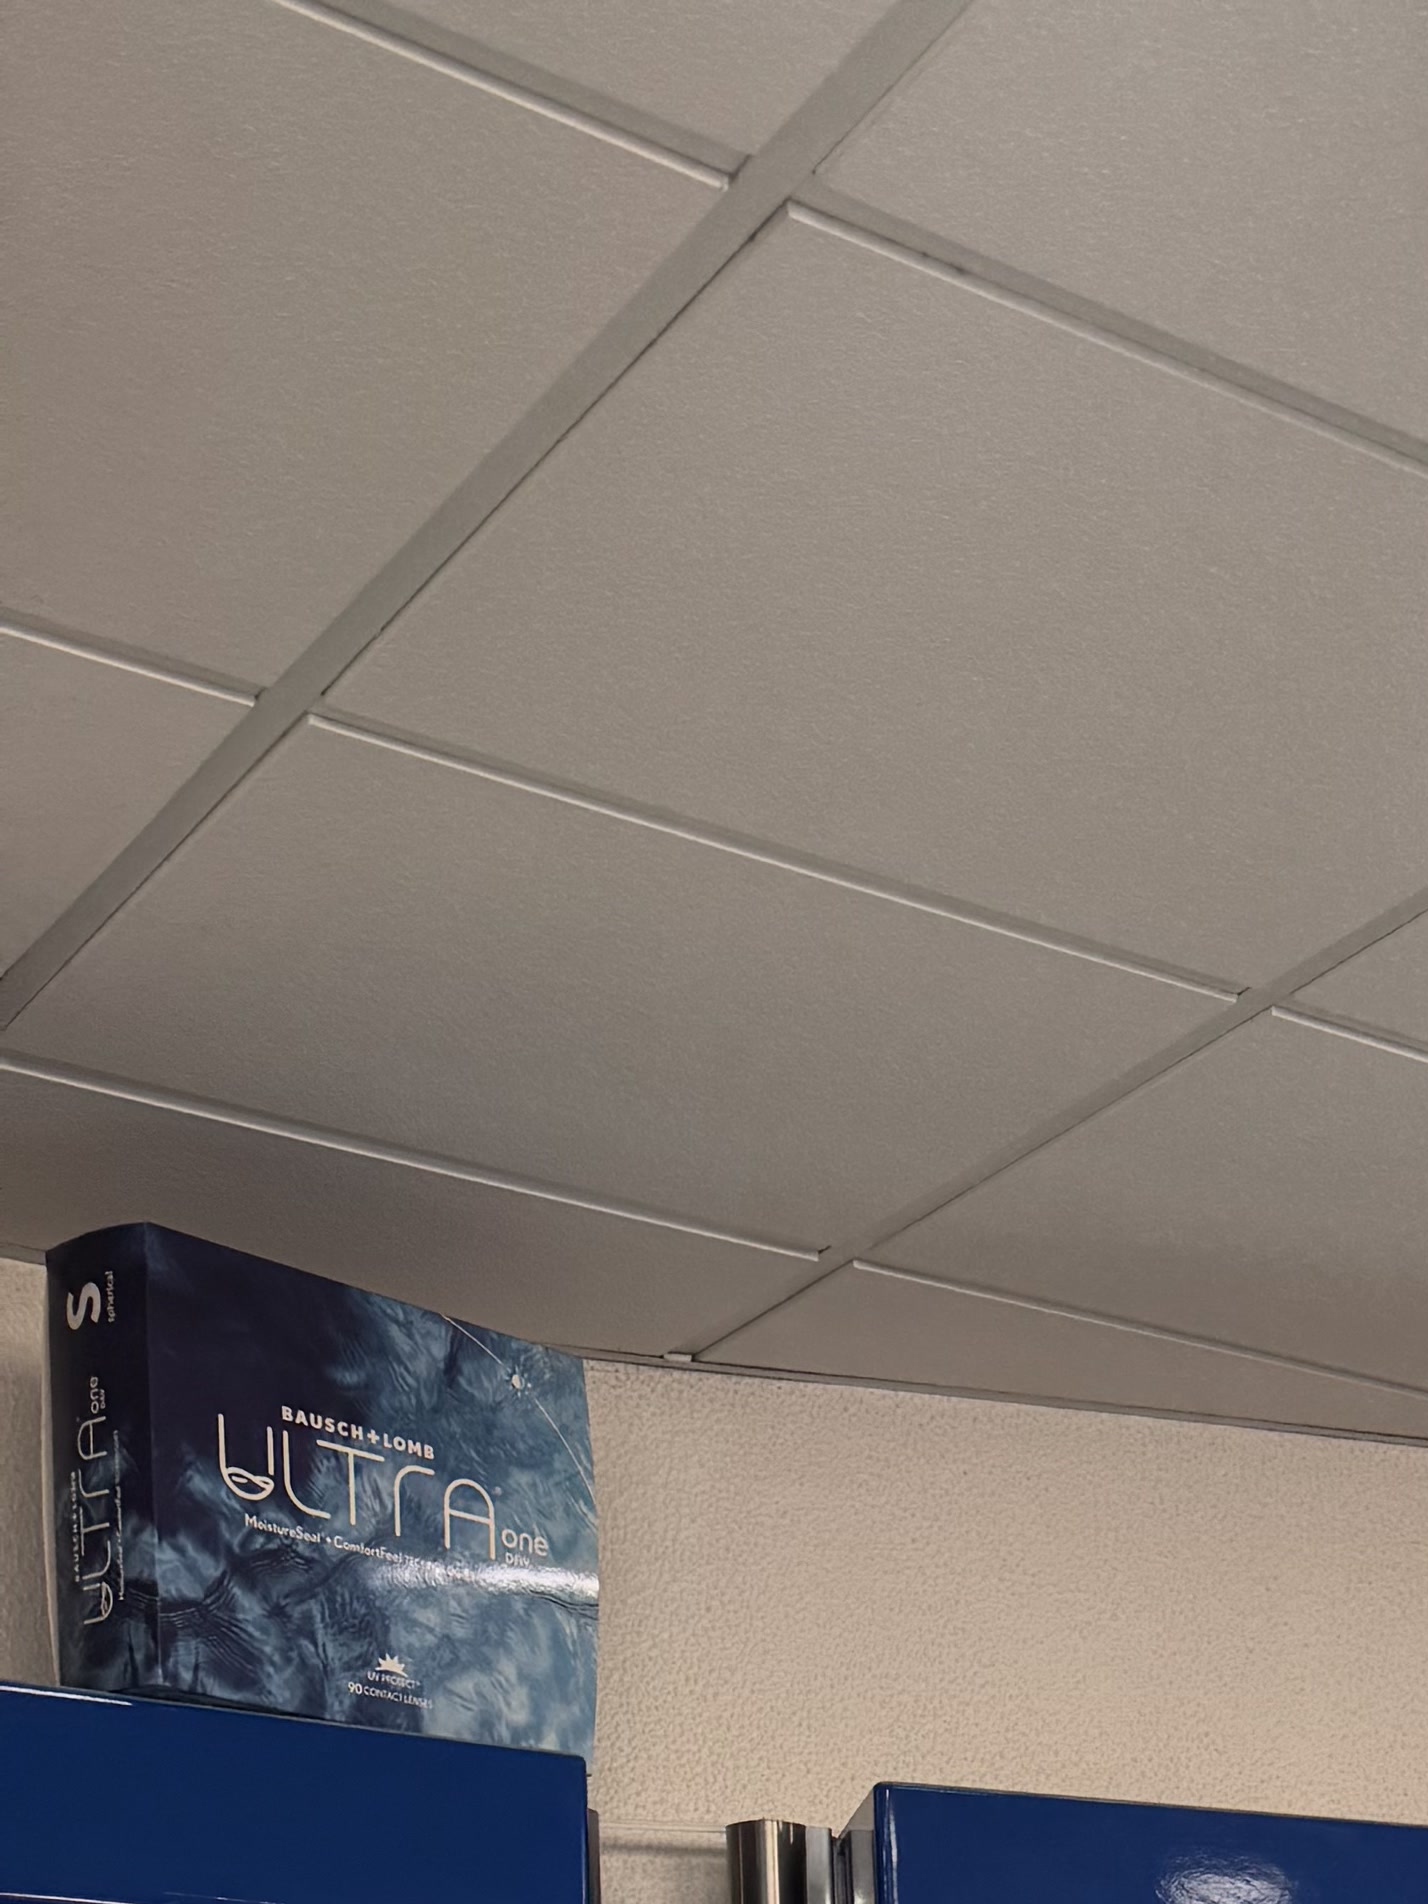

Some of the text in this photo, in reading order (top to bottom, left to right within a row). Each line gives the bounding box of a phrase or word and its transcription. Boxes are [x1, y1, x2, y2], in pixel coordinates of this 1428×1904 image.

[66, 1282, 101, 1331] S
[501, 1526, 549, 1556] one
[348, 1681, 362, 1694] 90
